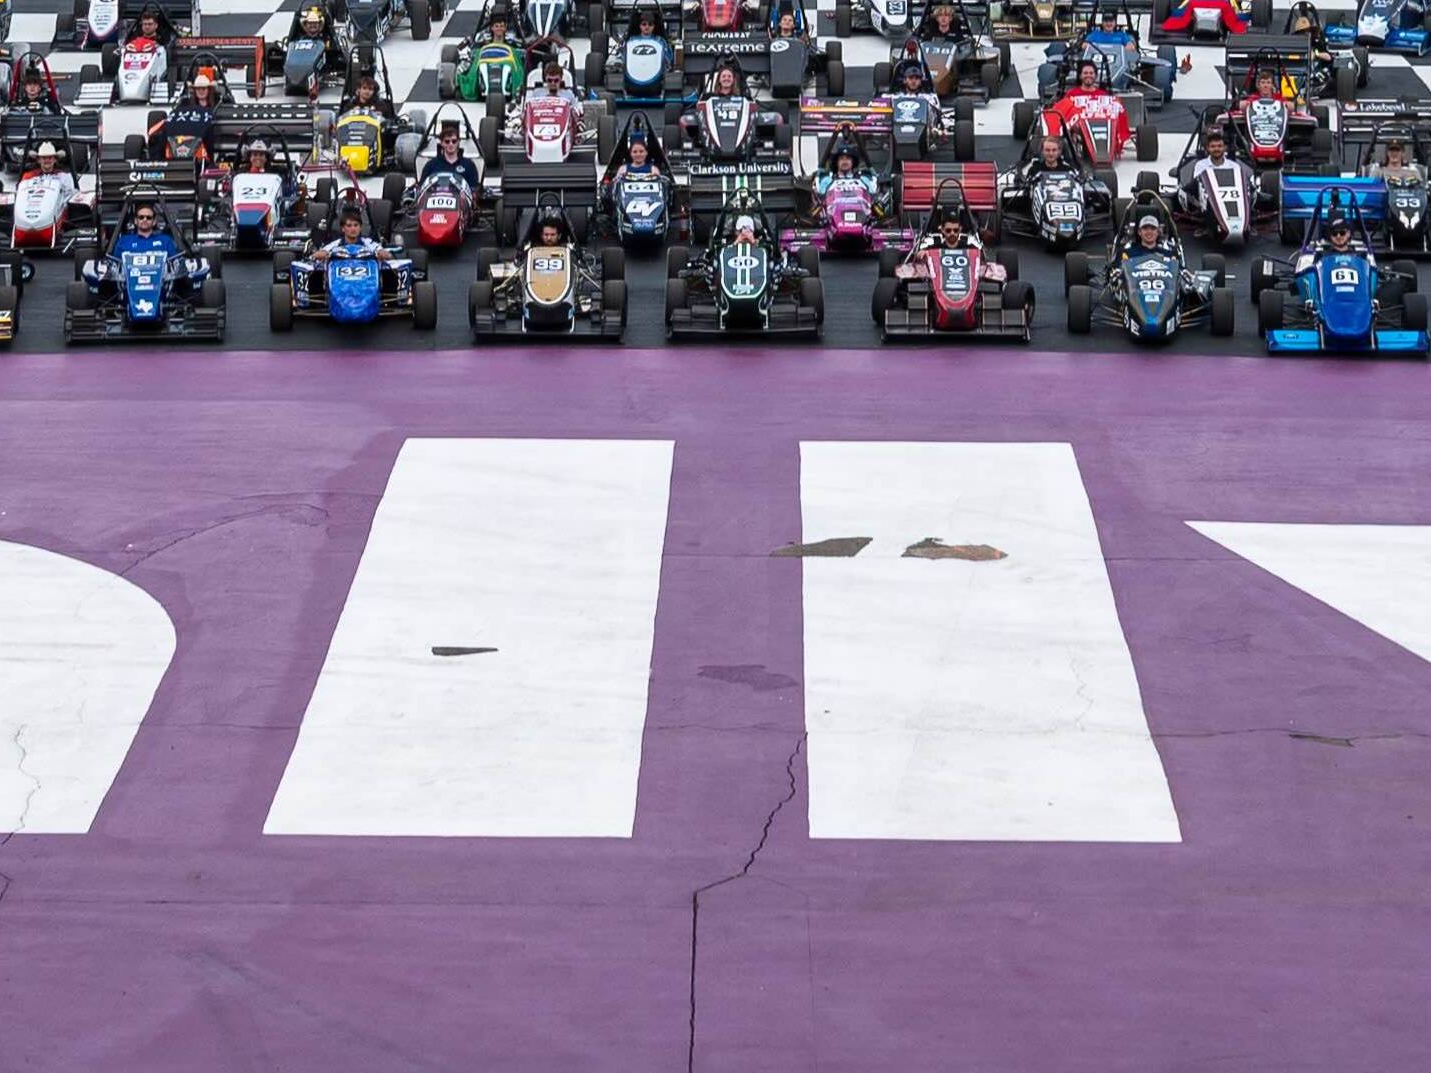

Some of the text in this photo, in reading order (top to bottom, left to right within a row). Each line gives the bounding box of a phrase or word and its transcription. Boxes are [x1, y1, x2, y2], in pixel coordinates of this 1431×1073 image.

[634, 45, 655, 54] 77
[1359, 102, 1406, 112] Lakehead
[690, 162, 791, 175] Clarkson University
[243, 187, 266, 196] 23
[628, 184, 655, 192] 64
[1219, 191, 1240, 199] 78
[431, 198, 453, 206] 100
[1395, 198, 1421, 207] 33
[1050, 204, 1079, 217] 99
[133, 256, 157, 265] 81
[535, 259, 562, 271] 39
[941, 256, 968, 267] 60
[340, 266, 367, 276] 32
[1336, 272, 1355, 281] 61
[1139, 281, 1165, 289] 96
